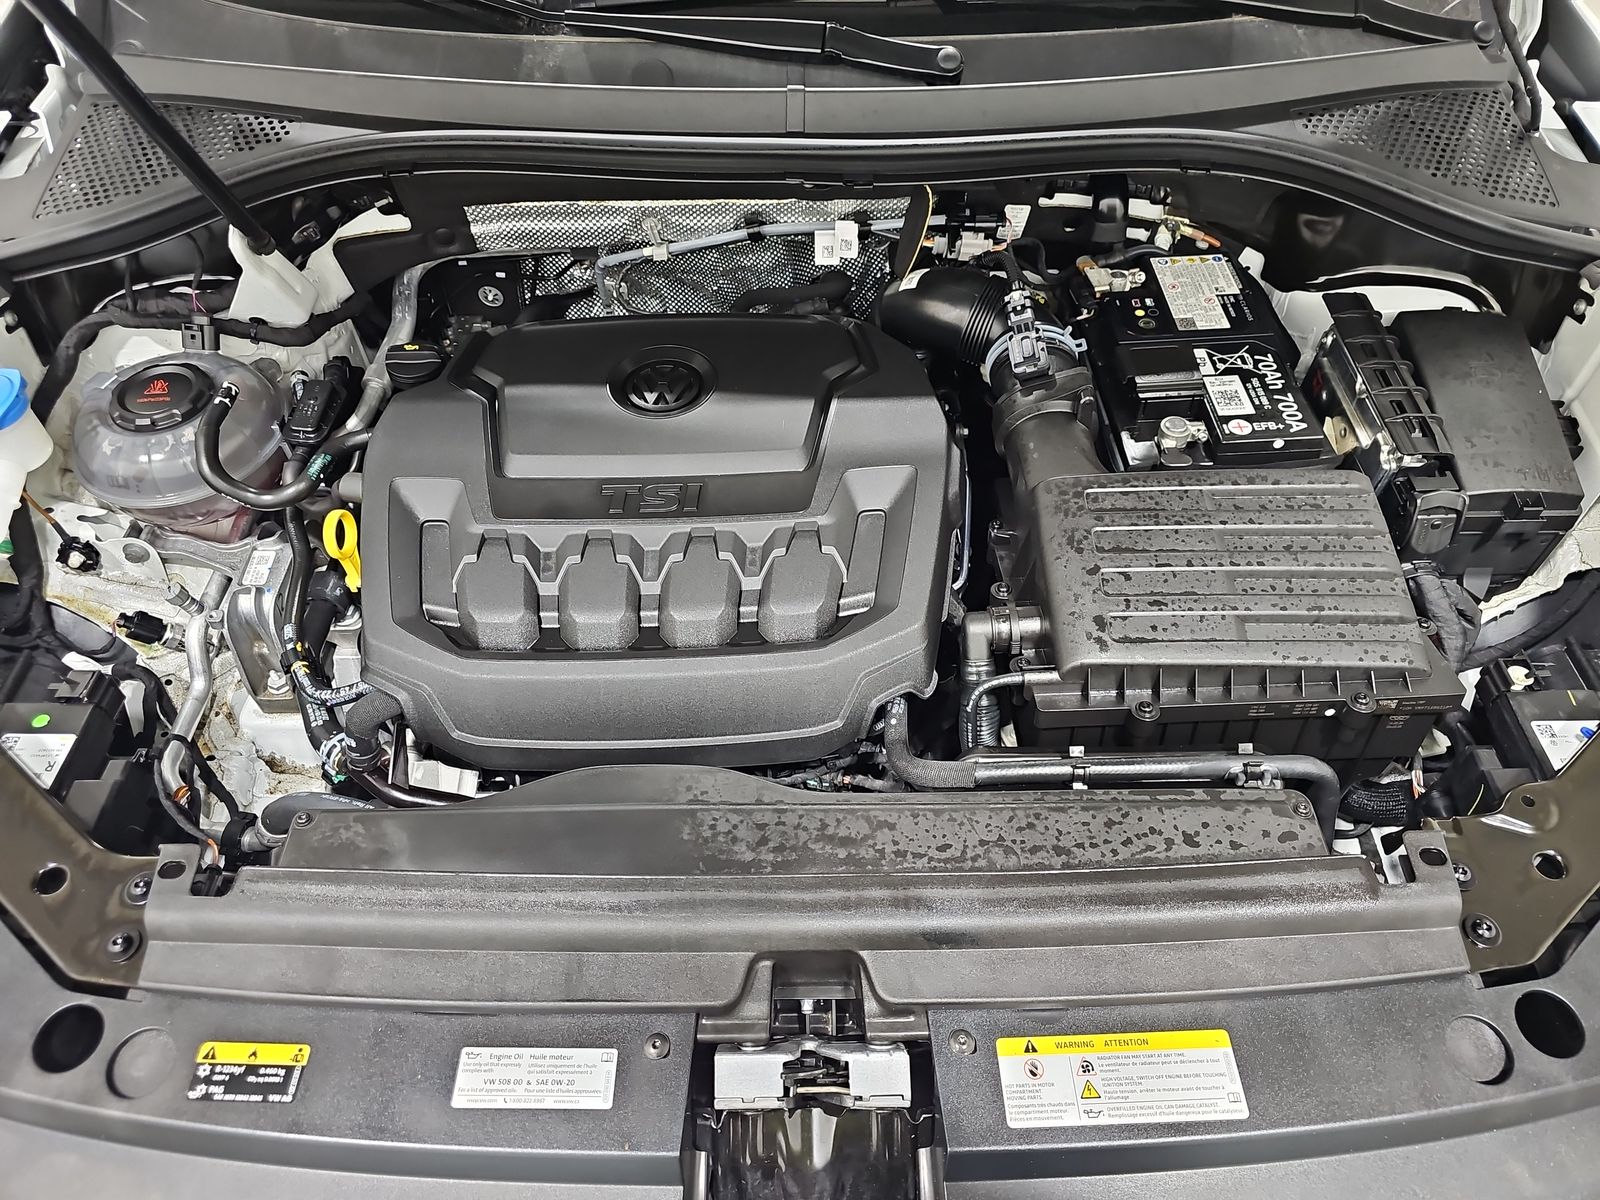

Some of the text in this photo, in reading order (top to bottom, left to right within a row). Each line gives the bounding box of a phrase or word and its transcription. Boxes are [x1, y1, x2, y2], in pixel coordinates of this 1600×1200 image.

[1196, 357, 1206, 367] Pb
[1254, 354, 1308, 433] 70Ah 700A
[1253, 422, 1285, 431] EFB+
[601, 483, 703, 513] TSI
[45, 761, 57, 772] R
[1055, 1038, 1149, 1049] WARNING ATTENTION
[490, 1053, 513, 1061] Engine
